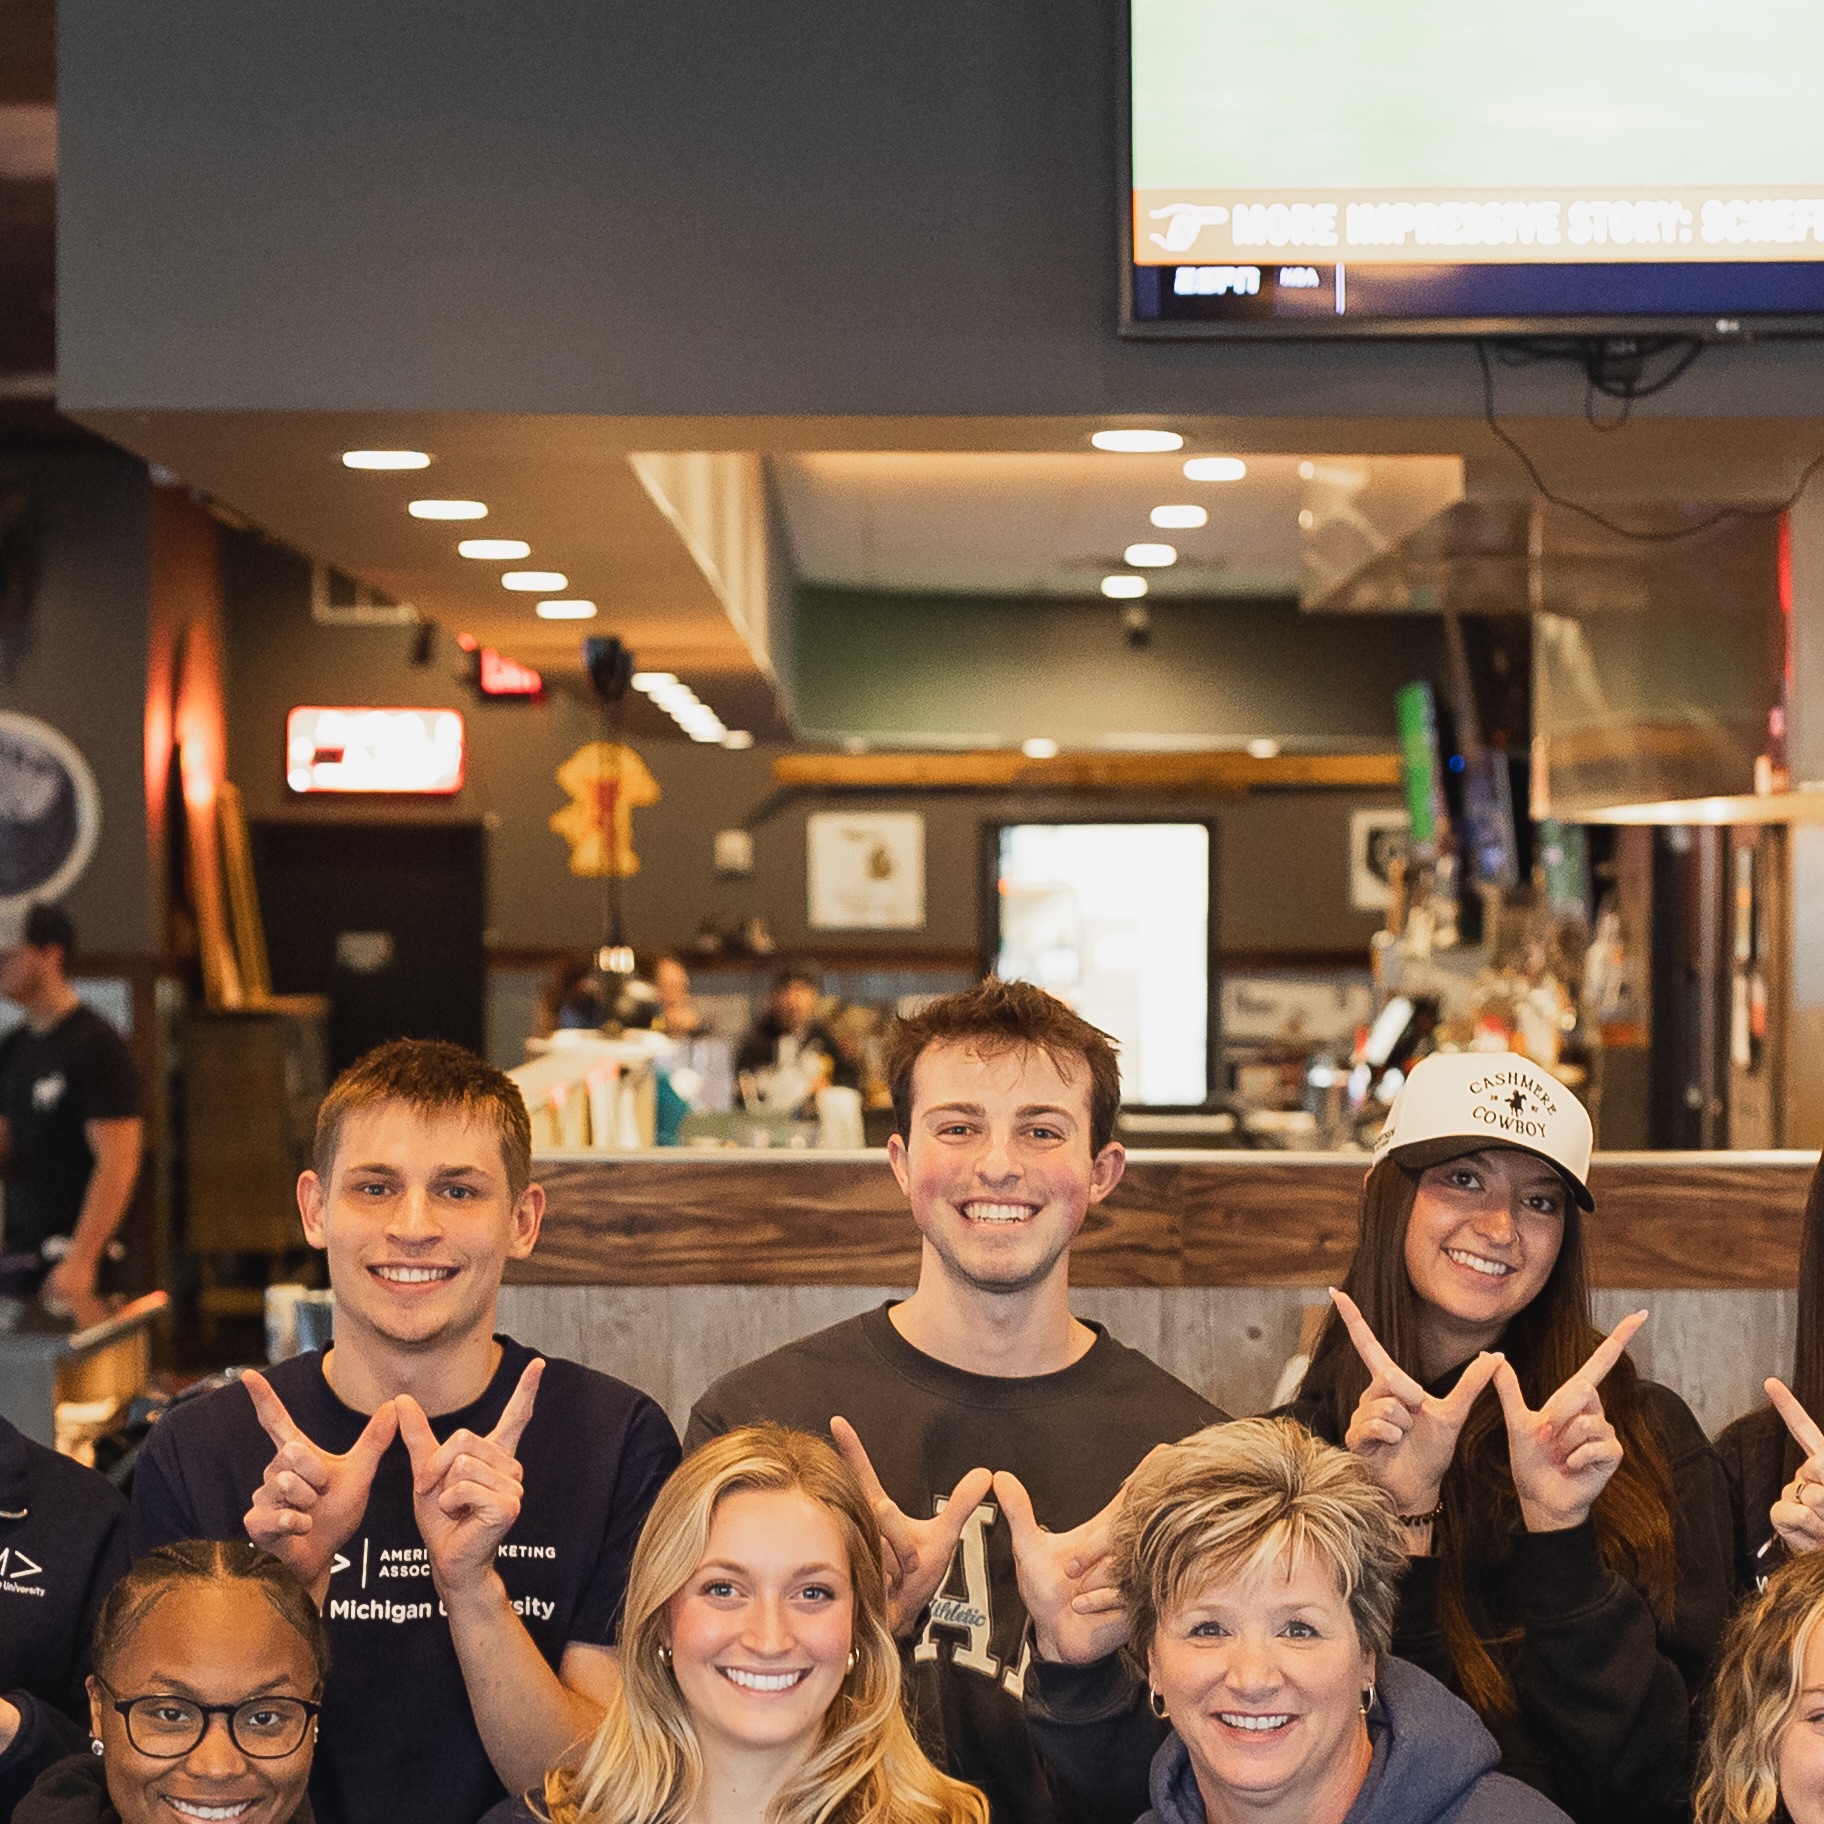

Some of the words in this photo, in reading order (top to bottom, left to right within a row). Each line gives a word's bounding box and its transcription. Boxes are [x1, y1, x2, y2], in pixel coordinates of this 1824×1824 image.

[1232, 203, 1338, 247] MORE
[1347, 201, 1561, 246] IMPRESSIVE
[1568, 199, 1692, 244] STORY:
[1175, 267, 1261, 295] ESPN
[1469, 1071, 1558, 1116] CASHMERE
[1472, 1105, 1546, 1138] COWBOY
[3, 1580, 46, 1598] University
[330, 1598, 432, 1624] Michigan
